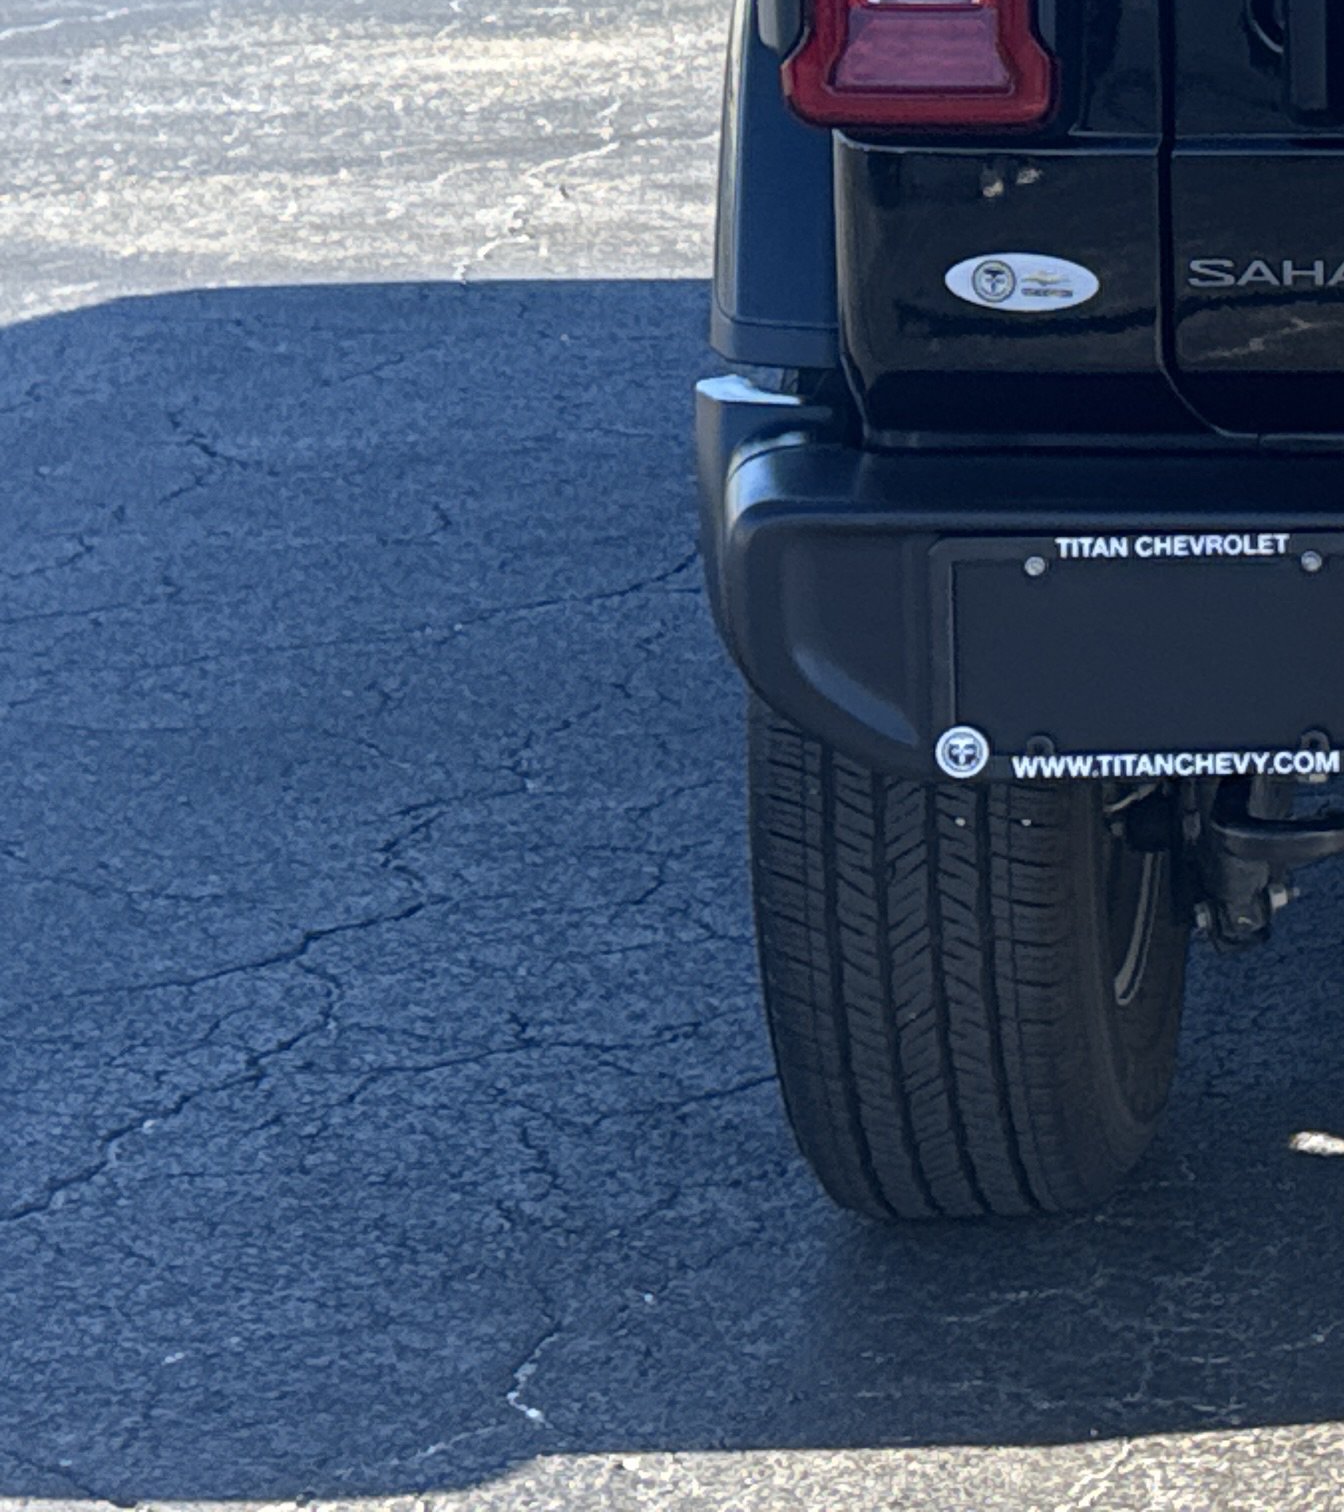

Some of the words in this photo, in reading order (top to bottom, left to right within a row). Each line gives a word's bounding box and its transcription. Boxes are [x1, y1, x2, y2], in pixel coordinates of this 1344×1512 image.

[1055, 537, 1128, 558] TITAN
[1134, 532, 1290, 557] CHEVROLET
[1011, 750, 1341, 779] WWW.TITANCHEVY.COM
